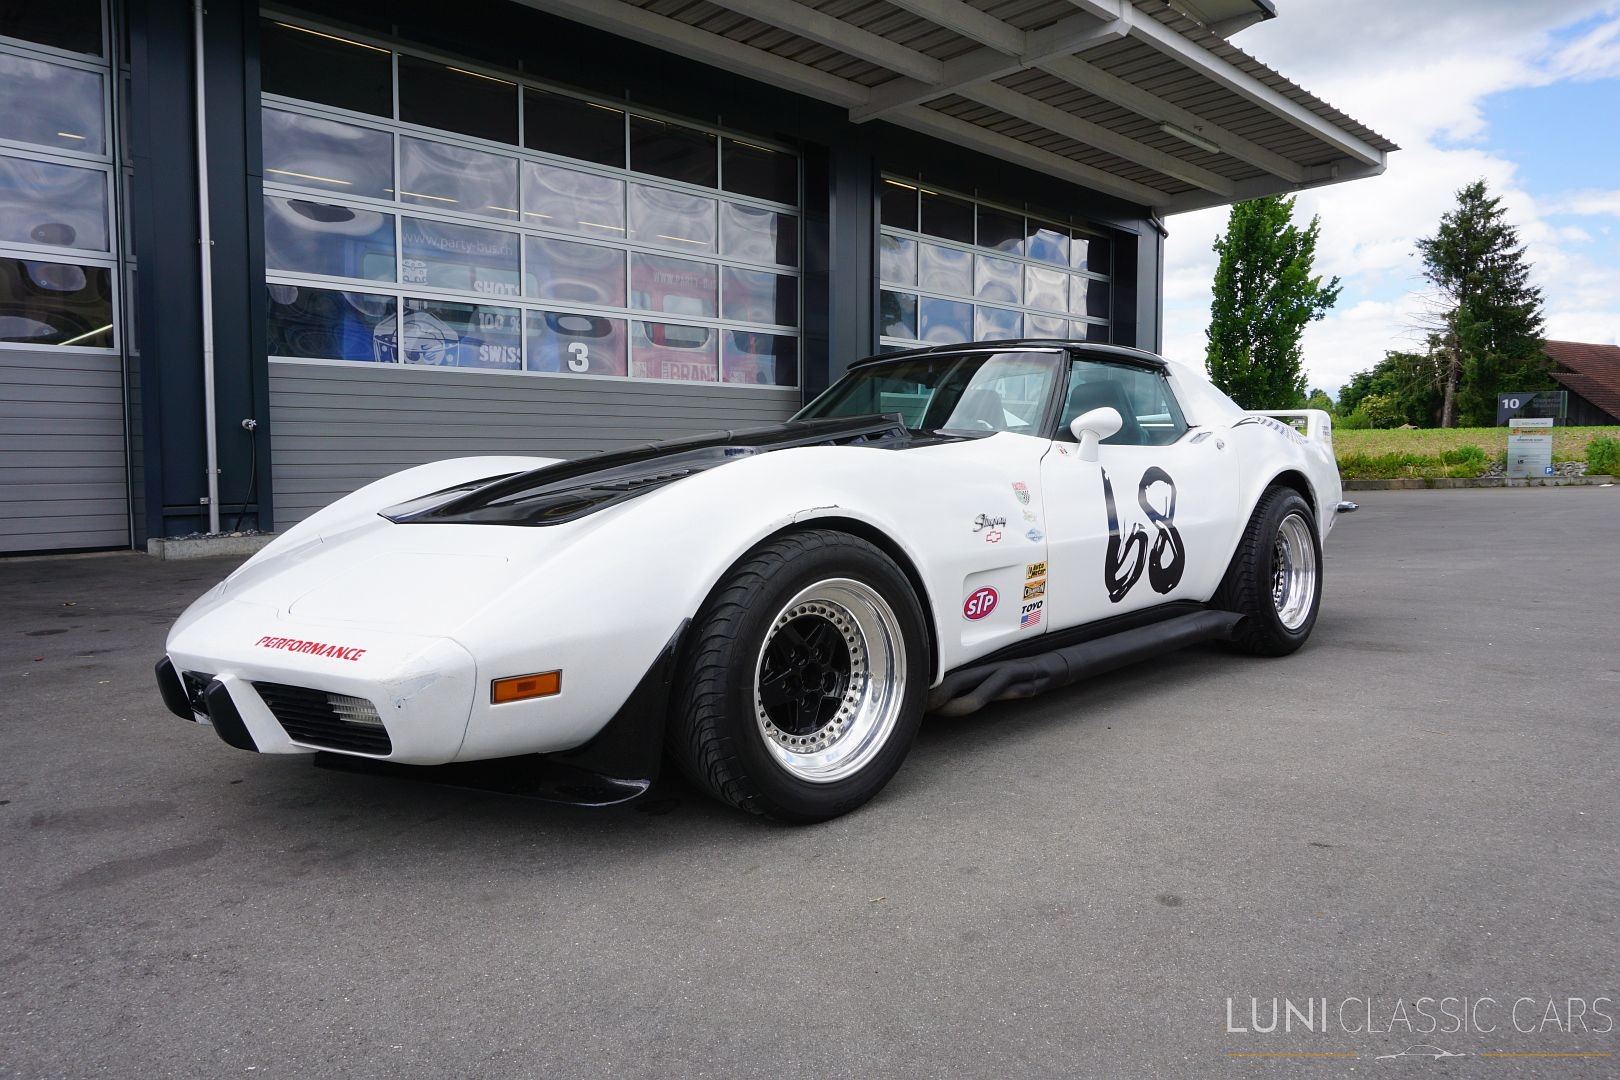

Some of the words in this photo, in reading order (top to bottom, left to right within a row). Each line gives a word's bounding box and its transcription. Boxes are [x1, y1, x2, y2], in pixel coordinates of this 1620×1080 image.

[479, 313, 504, 330] 100
[568, 342, 589, 372] 3
[1502, 398, 1520, 409] 10
[1101, 466, 1186, 604] 68
[967, 591, 994, 615] STP
[1021, 600, 1043, 614] TOYO
[255, 635, 367, 661] PERFORMANCE
